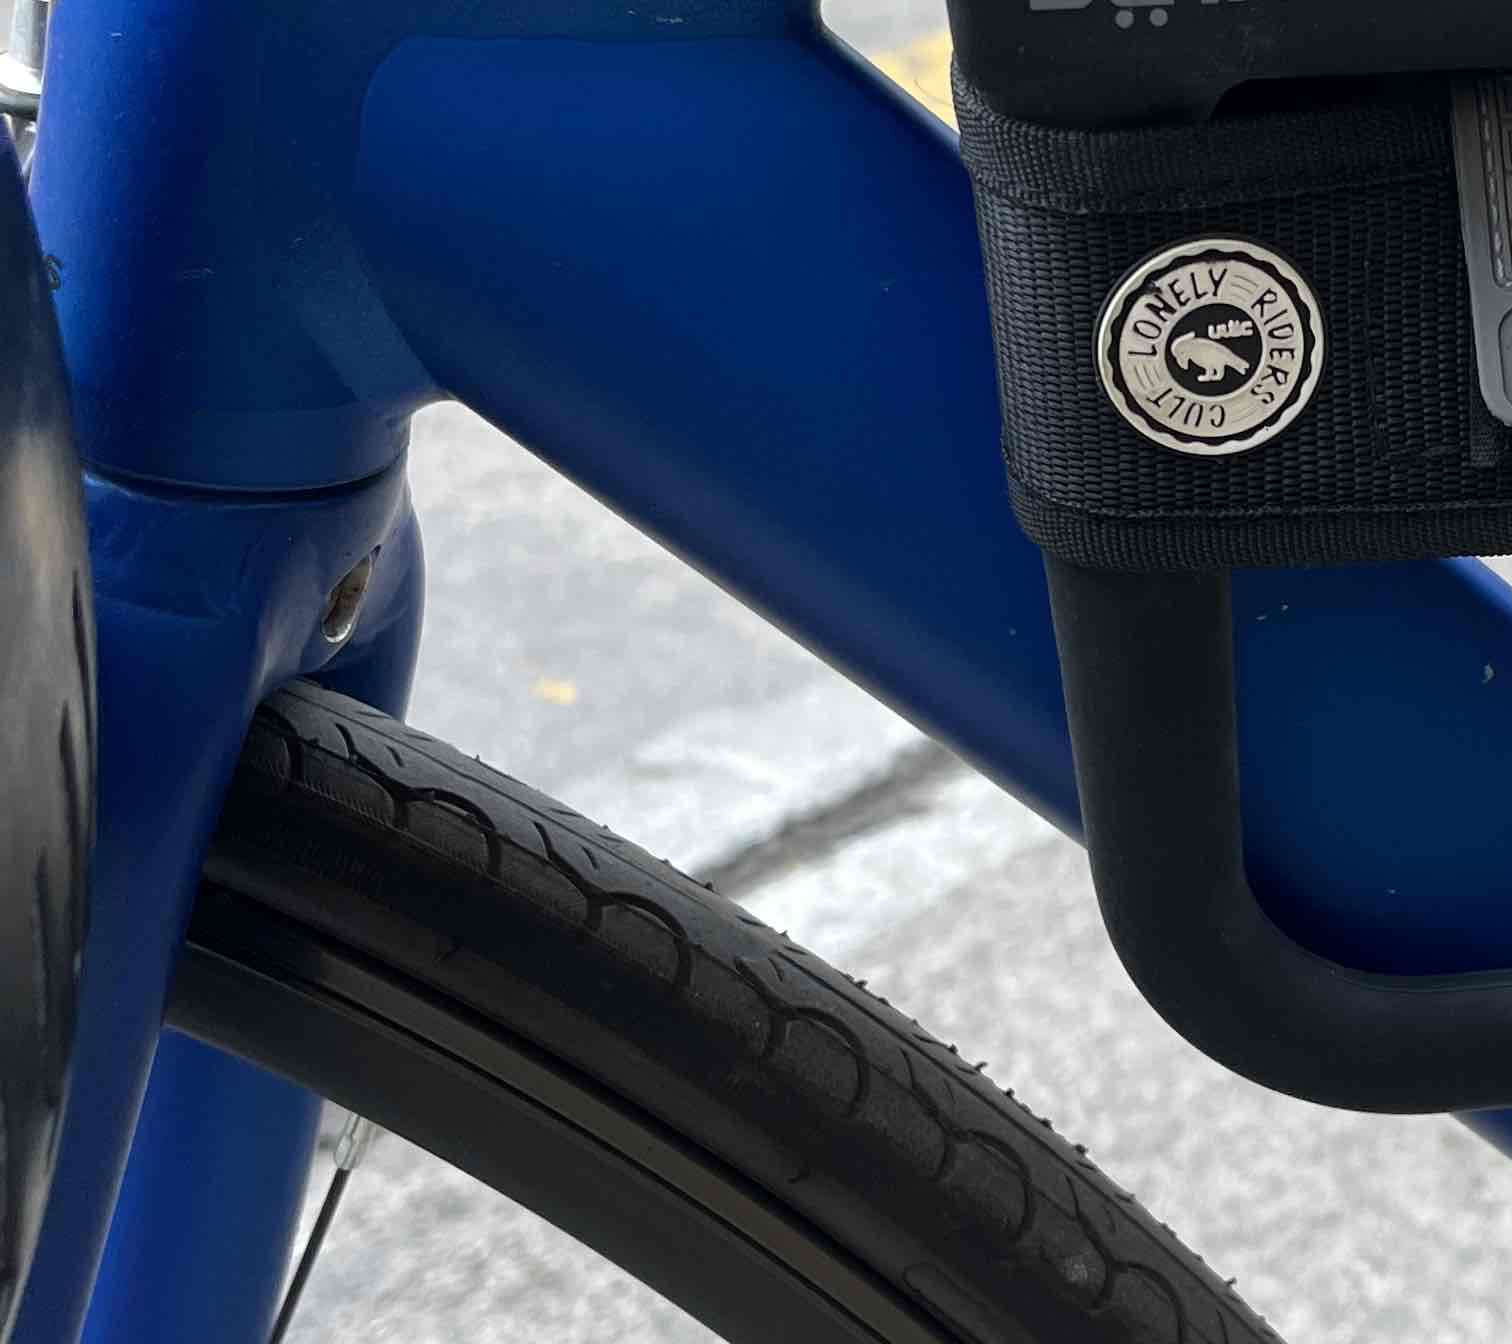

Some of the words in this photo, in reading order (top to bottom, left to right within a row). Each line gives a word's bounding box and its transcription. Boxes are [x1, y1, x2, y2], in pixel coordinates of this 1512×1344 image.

[1128, 267, 1228, 359] LONELY
[1252, 287, 1295, 405] RIDERS
[1146, 386, 1226, 428] CULT
